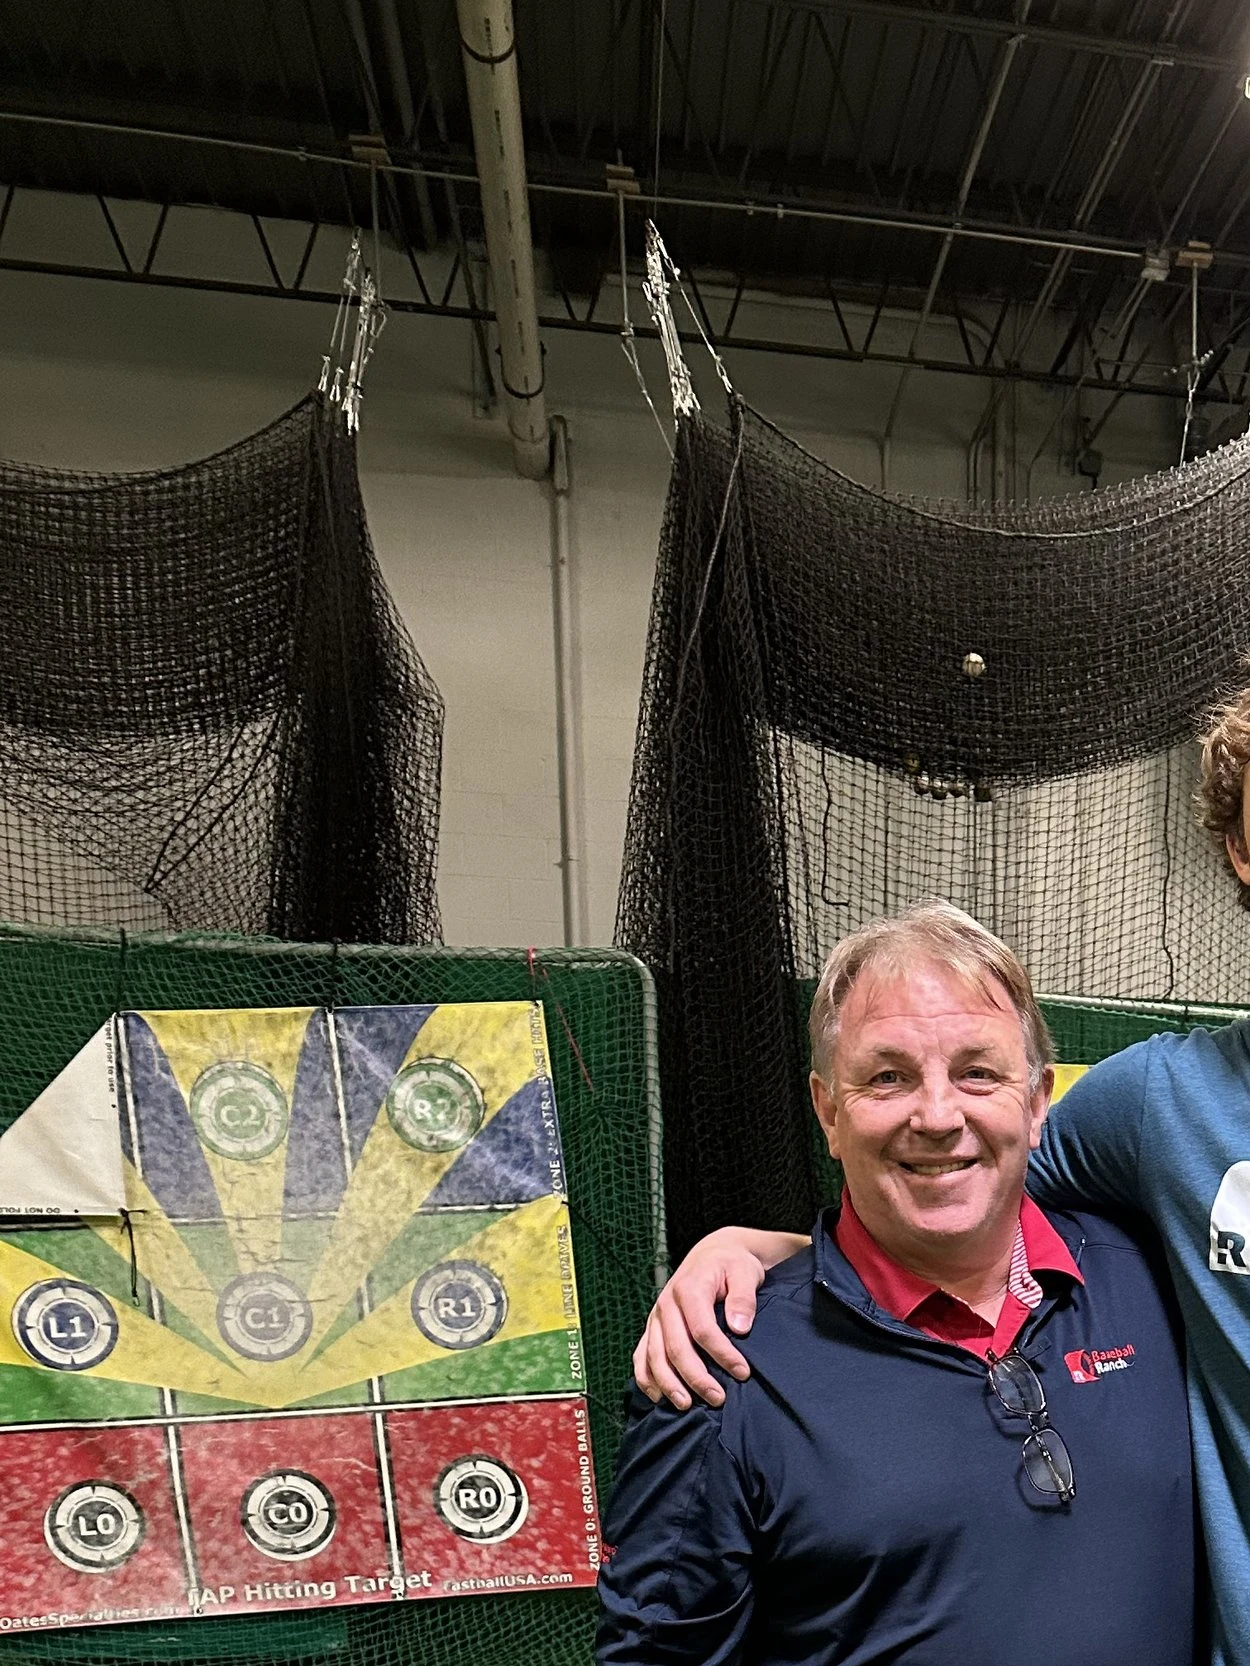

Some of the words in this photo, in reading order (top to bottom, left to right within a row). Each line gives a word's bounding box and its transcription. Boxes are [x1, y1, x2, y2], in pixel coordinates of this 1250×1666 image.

[107, 1077, 115, 1093] use
[219, 1103, 264, 1127] C2
[412, 1098, 451, 1121] R2
[1216, 1231, 1247, 1268] R
[245, 1307, 286, 1330] C1
[440, 1297, 477, 1319] R1
[49, 1316, 88, 1339] L1
[568, 1341, 582, 1380] ZONE
[1091, 1344, 1136, 1362] Baseball
[1094, 1357, 1128, 1375] Ranch
[574, 1409, 588, 1451] BALLS
[579, 1455, 594, 1514] GROUND
[458, 1487, 496, 1509] R0
[77, 1512, 115, 1537] L0
[267, 1502, 307, 1525] C0
[584, 1518, 597, 1530] 0:
[586, 1534, 601, 1571] ZONE
[245, 1575, 336, 1602] Hitting
[344, 1570, 433, 1596] Target
